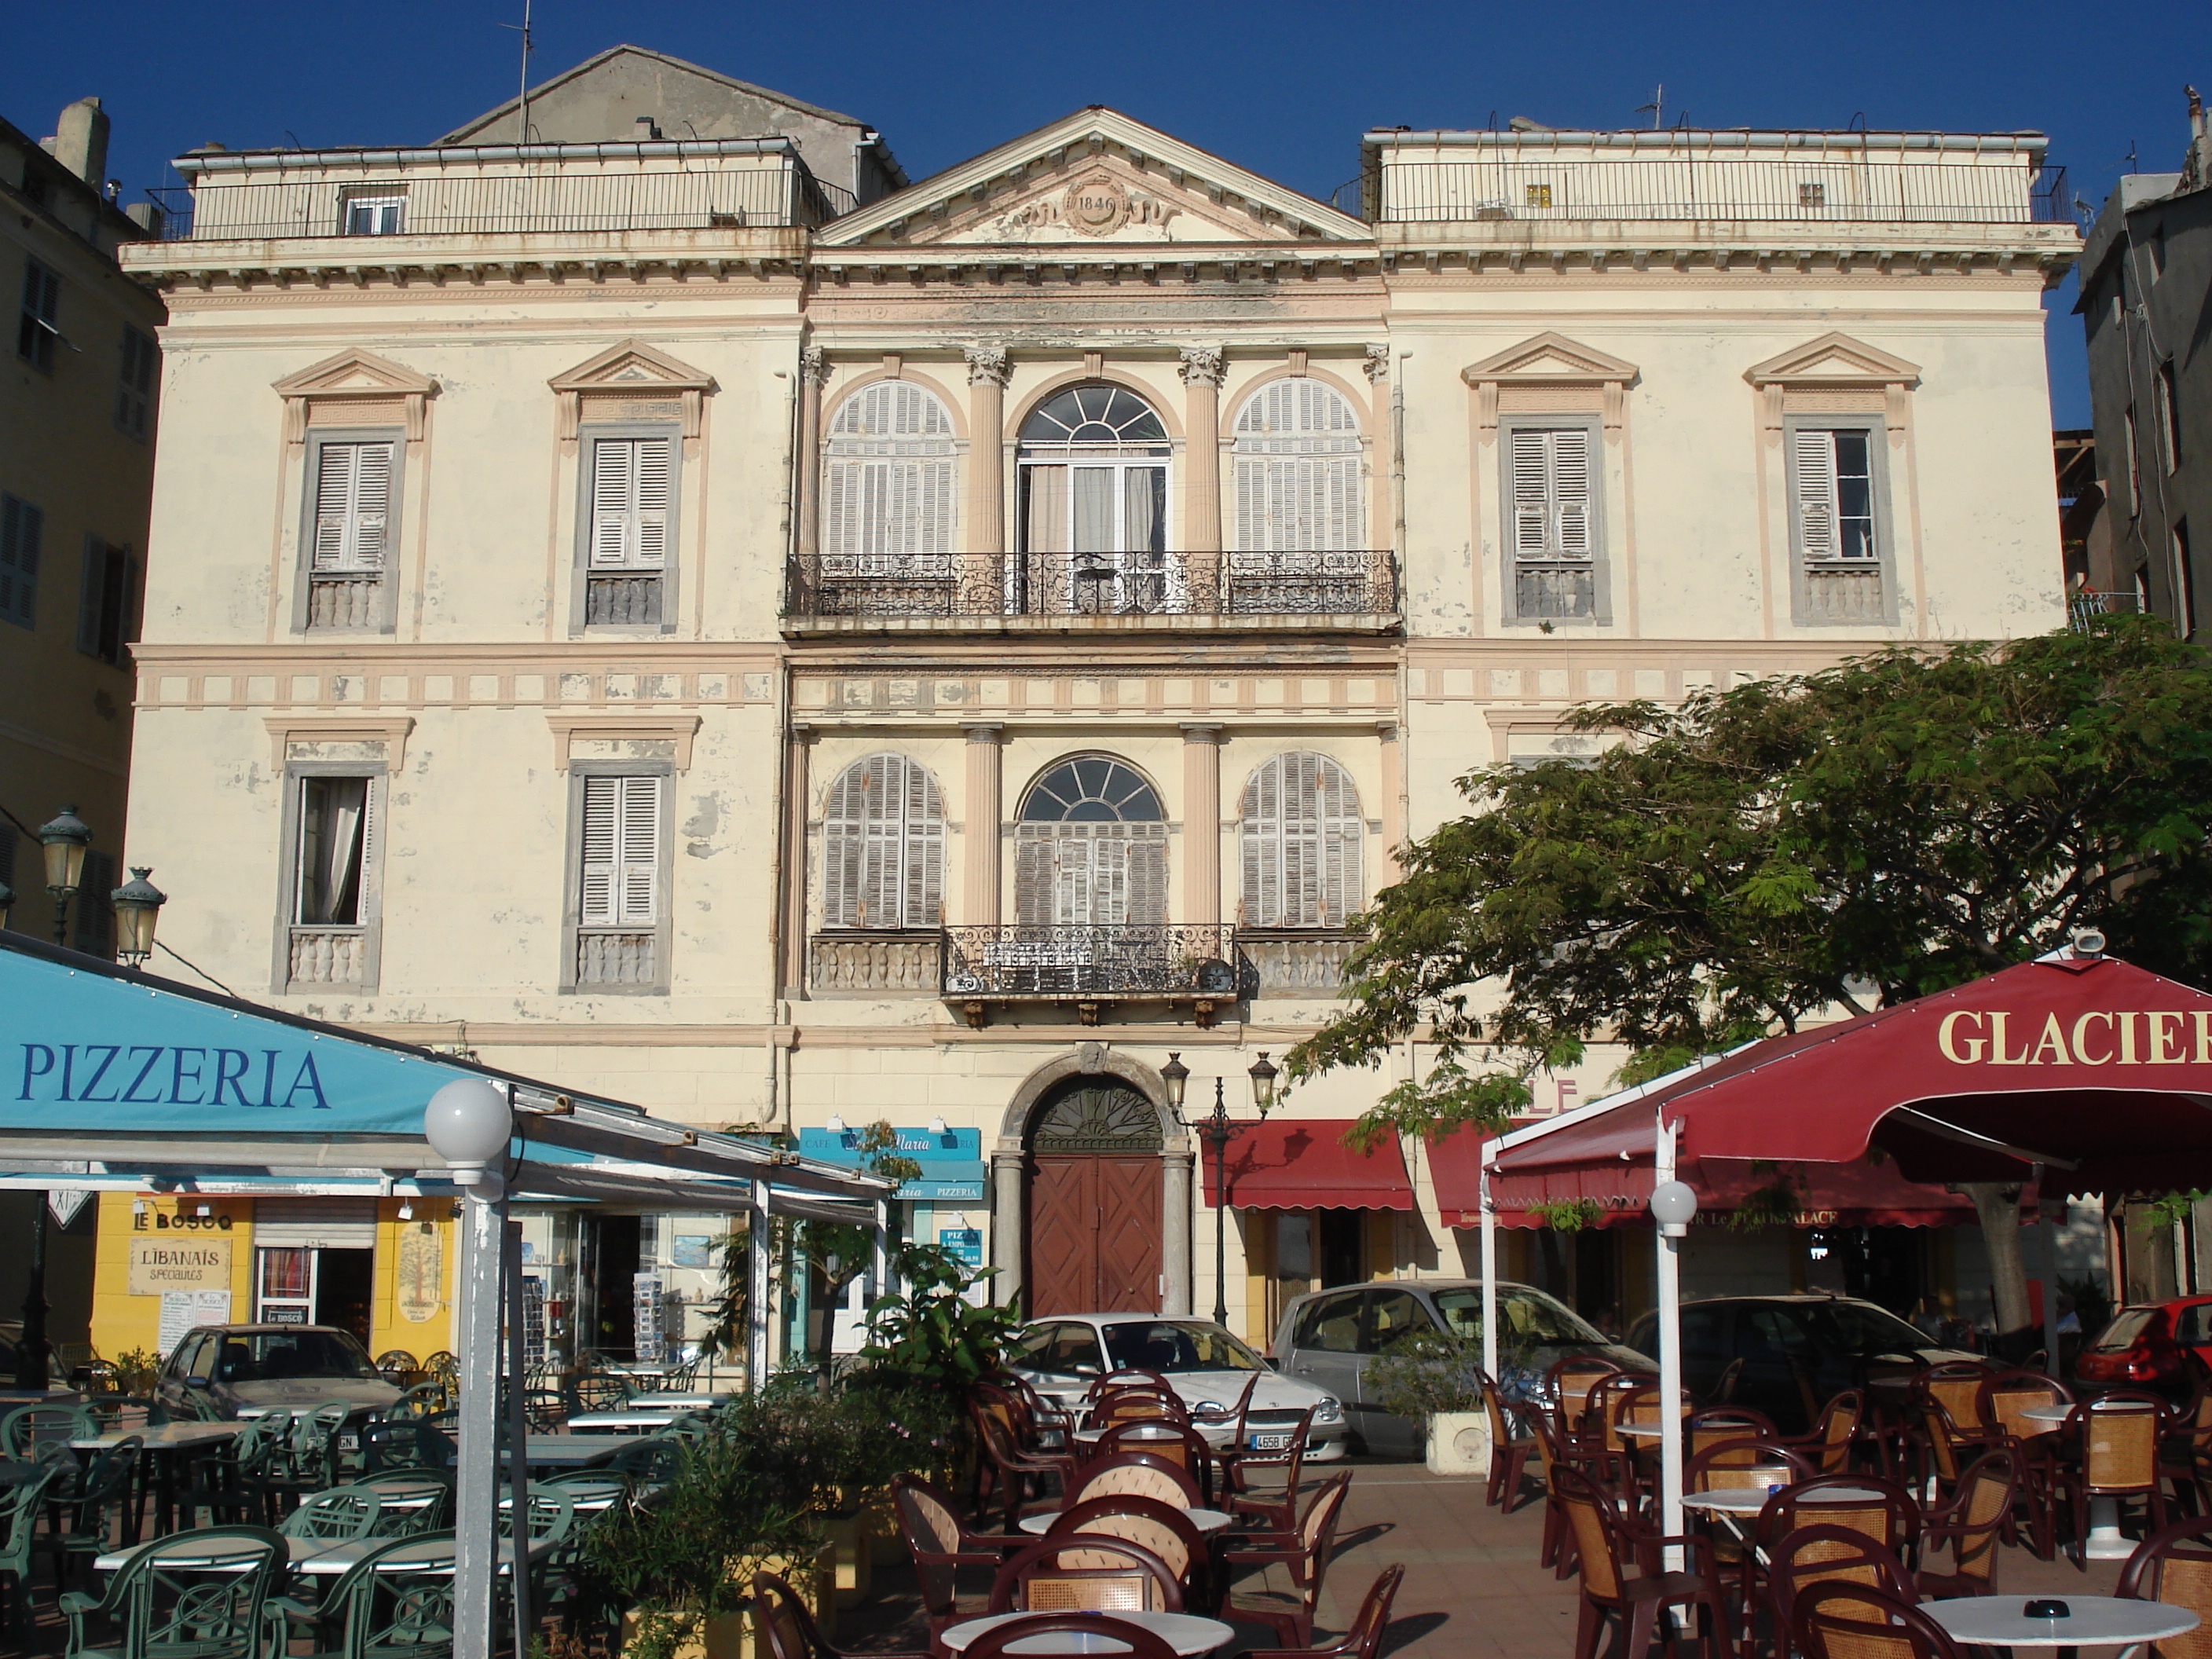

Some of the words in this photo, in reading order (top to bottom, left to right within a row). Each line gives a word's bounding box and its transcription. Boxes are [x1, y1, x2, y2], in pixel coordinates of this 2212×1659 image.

[1079, 196, 1115, 211] 1846
[15, 1043, 332, 1109] PIZZERIA
[1528, 1079, 1578, 1114] LE
[889, 1133, 932, 1151] Maria
[896, 1186, 924, 1197] aria
[936, 1187, 977, 1197] PIZZERIA
[134, 1212, 148, 1232] LE
[156, 1213, 232, 1230] BOSCO
[277, 1313, 303, 1323] BOSCO
[1258, 1437, 1280, 1448] 4658
